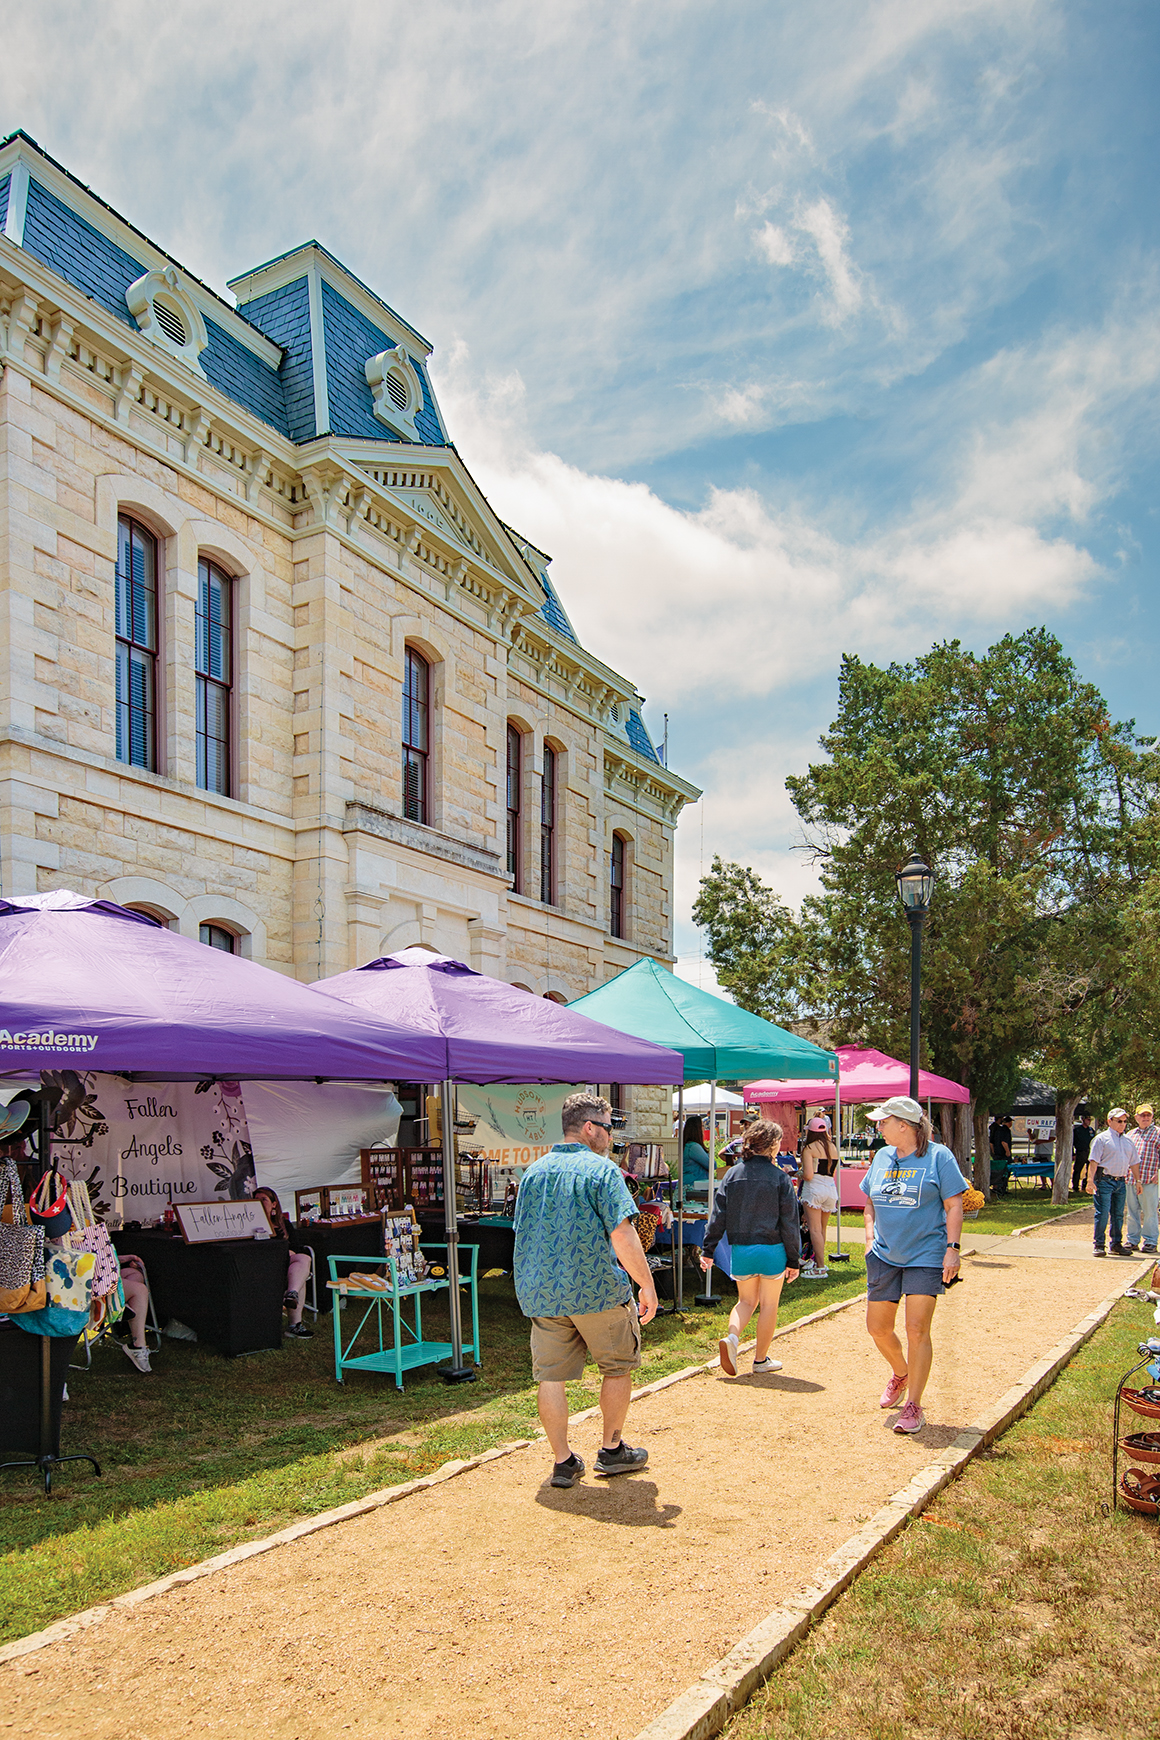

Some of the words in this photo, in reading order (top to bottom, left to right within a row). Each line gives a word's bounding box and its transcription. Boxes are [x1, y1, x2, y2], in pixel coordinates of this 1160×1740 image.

[0, 1029, 98, 1051] Academy
[0, 1044, 88, 1052] PORTS+OUTDOORS
[124, 1097, 178, 1119] Fallen
[524, 1127, 545, 1141] TABLE
[121, 1134, 183, 1165] Angels
[478, 1148, 510, 1166] OME
[513, 1147, 531, 1164] TO
[533, 1145, 553, 1161] TH
[110, 1175, 197, 1203] Boutique
[188, 1207, 223, 1232] Fallen
[222, 1204, 255, 1229] Angels
